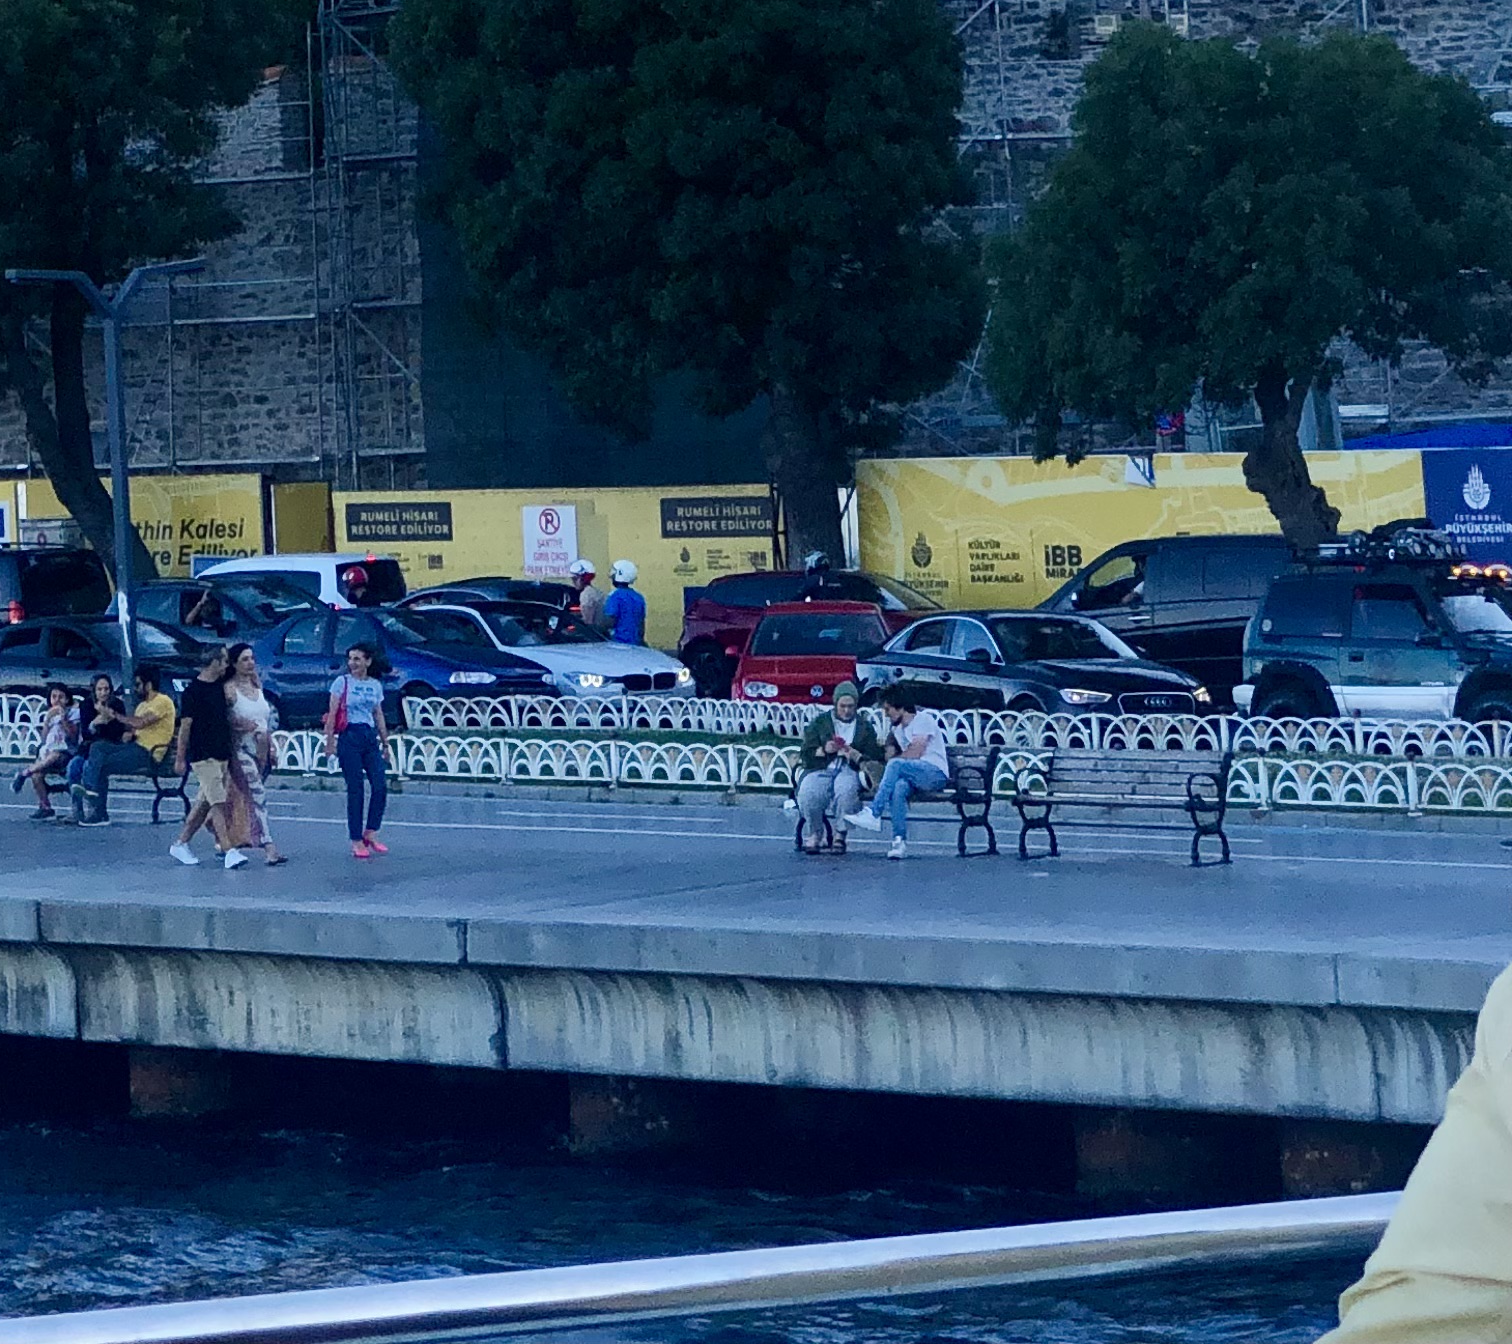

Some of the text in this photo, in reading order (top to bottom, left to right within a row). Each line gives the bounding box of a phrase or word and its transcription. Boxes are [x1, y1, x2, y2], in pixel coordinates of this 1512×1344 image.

[360, 508, 438, 521] RUMELİ HİSARI
[677, 503, 761, 517] RUMELİ HİSARI
[180, 517, 244, 540] Kalesi
[351, 522, 449, 536] RESTORE EDİLİYOR
[666, 518, 773, 532] RESTORE EDİLİYOR
[968, 538, 1001, 550] KÜLTÜR
[969, 551, 1021, 561] VARLIKLARI
[1044, 567, 1083, 579] MİRA
